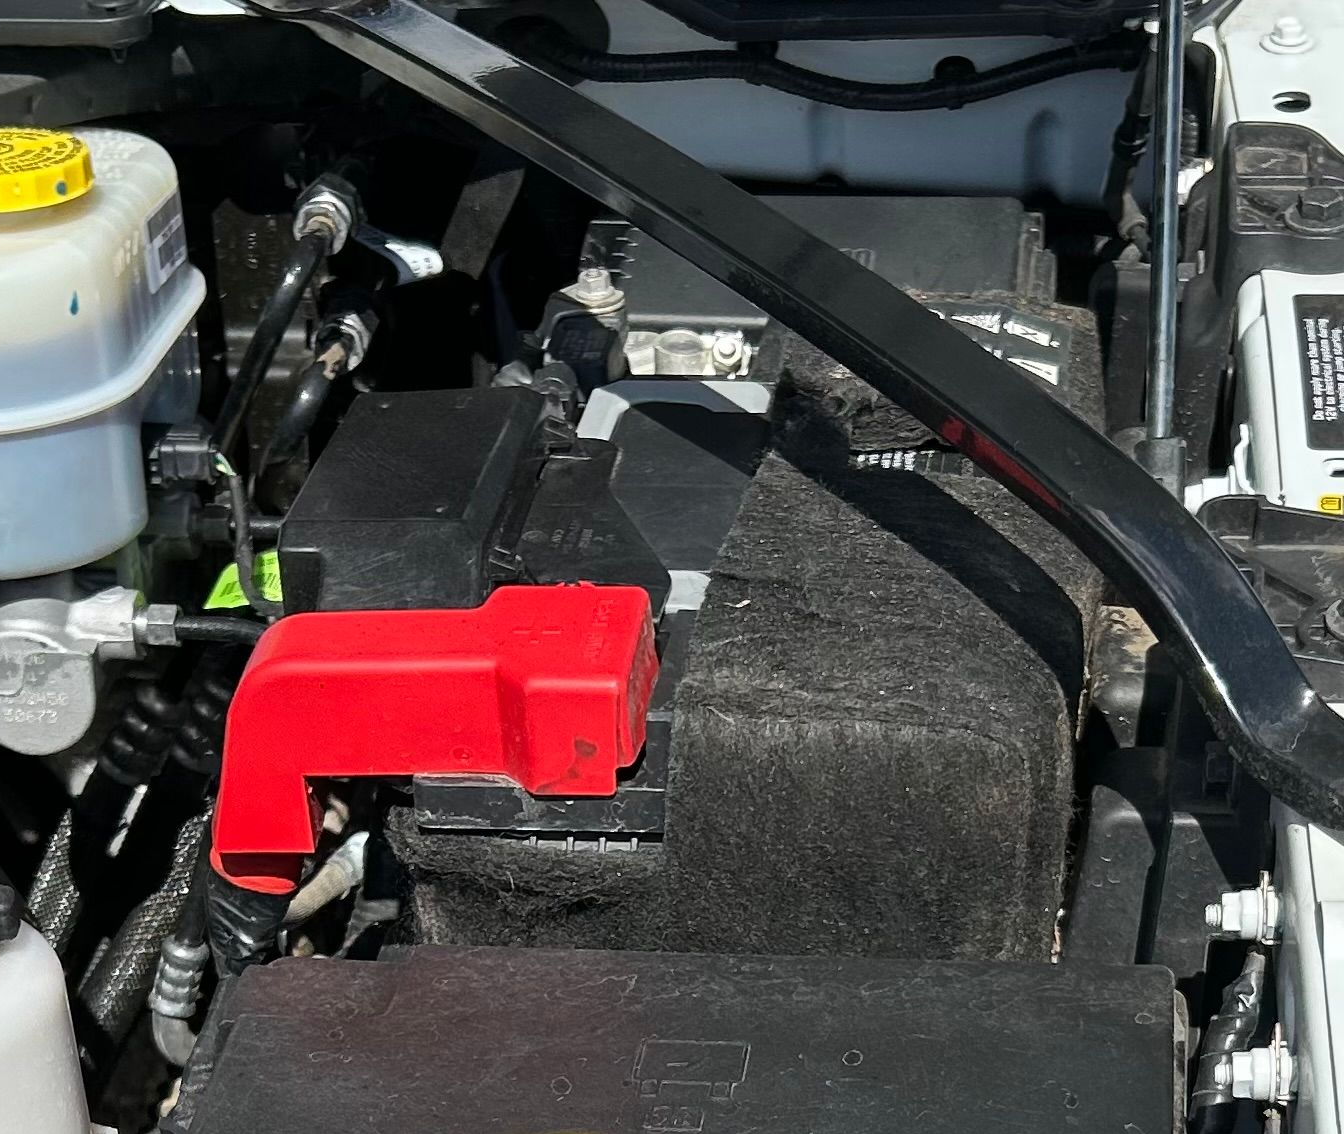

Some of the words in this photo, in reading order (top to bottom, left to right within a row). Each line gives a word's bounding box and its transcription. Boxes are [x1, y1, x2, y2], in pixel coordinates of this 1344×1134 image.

[1317, 319, 1329, 338] during
[1307, 343, 1318, 358] than
[1320, 339, 1333, 362] system
[1310, 359, 1320, 376] more
[1320, 363, 1334, 395] electrical
[1337, 373, 1344, 381] or
[1310, 377, 1326, 395] apply
[1312, 410, 1324, 420] Do
[1325, 406, 1338, 421] 12V
